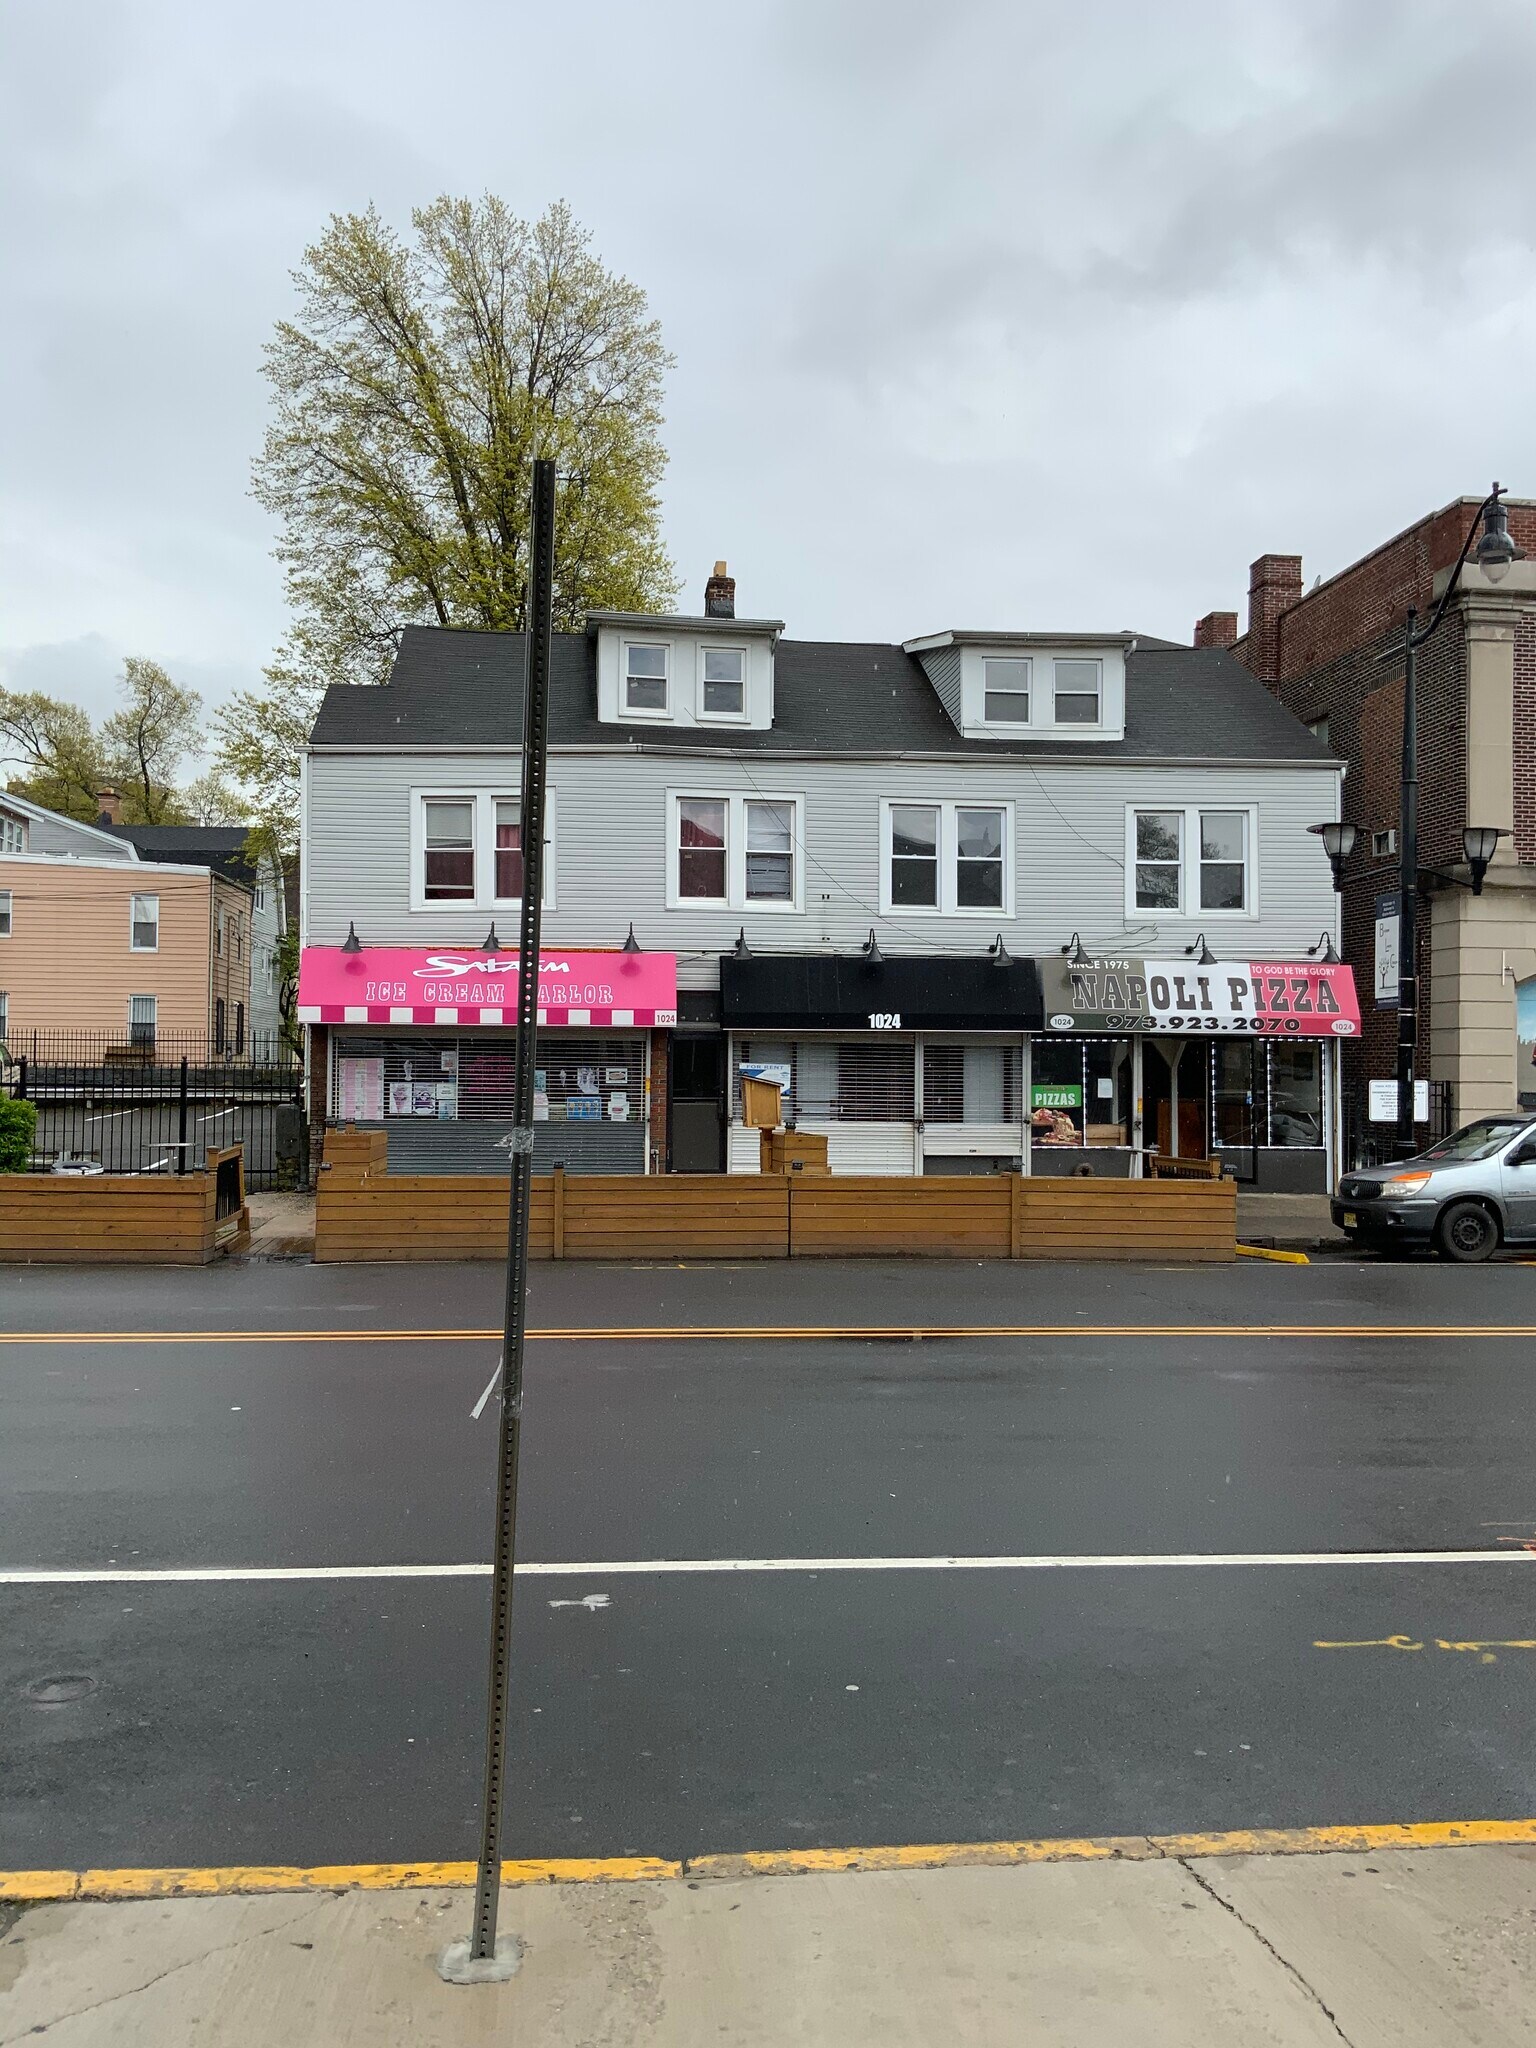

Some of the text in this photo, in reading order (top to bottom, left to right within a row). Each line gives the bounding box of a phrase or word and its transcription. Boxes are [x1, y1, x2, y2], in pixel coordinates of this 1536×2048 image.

[1104, 960, 1130, 970] 1975
[1251, 965, 1335, 976] TO GOD BE THE GLORY
[365, 982, 614, 1004] ICE CREAM ARLOR
[1070, 973, 1341, 1014] NAPOLI PIZZA
[656, 1014, 675, 1023] 1024
[867, 1013, 901, 1029] 1024
[1053, 1017, 1072, 1027] 1024
[1105, 1013, 1301, 1031] 973.923.2070
[1335, 1022, 1353, 1032] 1024
[1035, 1092, 1076, 1106] PIZZAS
